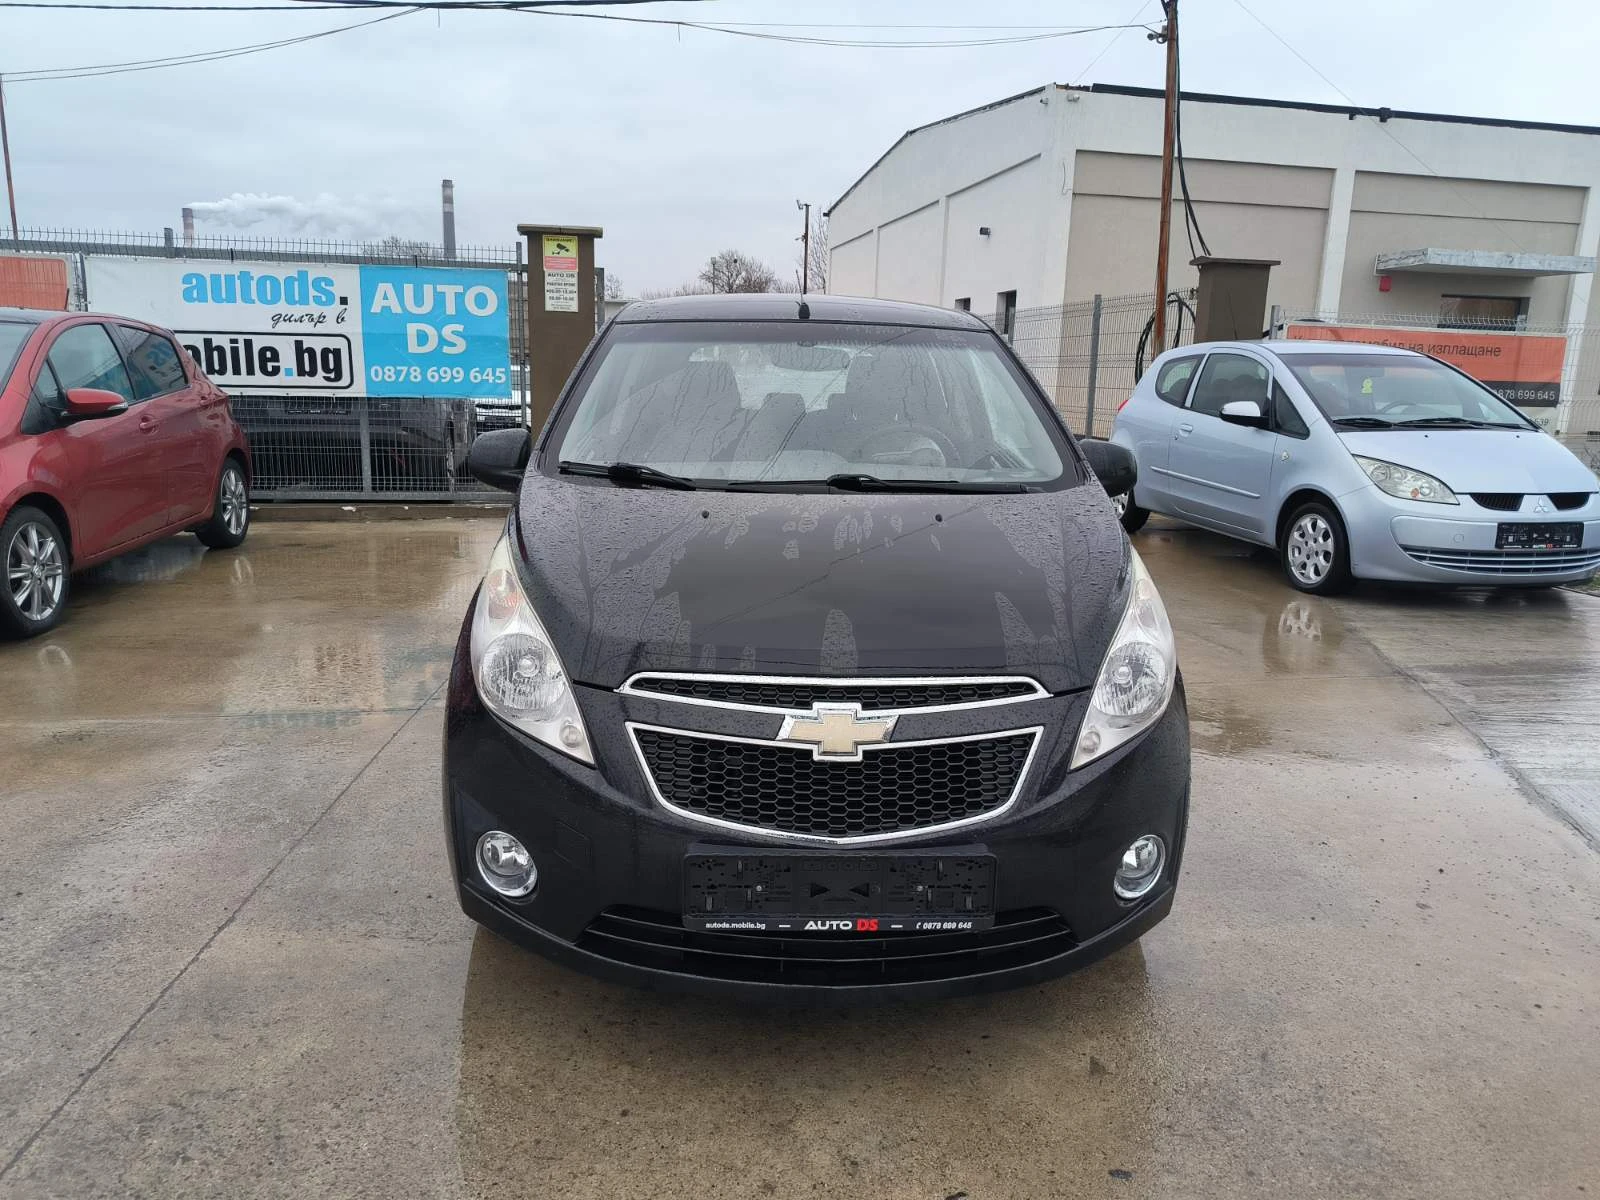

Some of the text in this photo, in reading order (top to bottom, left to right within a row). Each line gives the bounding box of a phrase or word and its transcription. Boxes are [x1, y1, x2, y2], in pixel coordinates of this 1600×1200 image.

[182, 269, 348, 307] autods.
[370, 282, 498, 315] AUTO
[271, 312, 327, 328] дилър
[406, 323, 467, 354] DS
[1427, 344, 1502, 359] изплащане
[370, 365, 506, 385] 0878 699 645
[1517, 390, 1536, 400] 699
[1537, 391, 1556, 401] 645
[804, 920, 852, 930] AUTO
[856, 919, 879, 931] DS
[958, 921, 973, 929] 645
